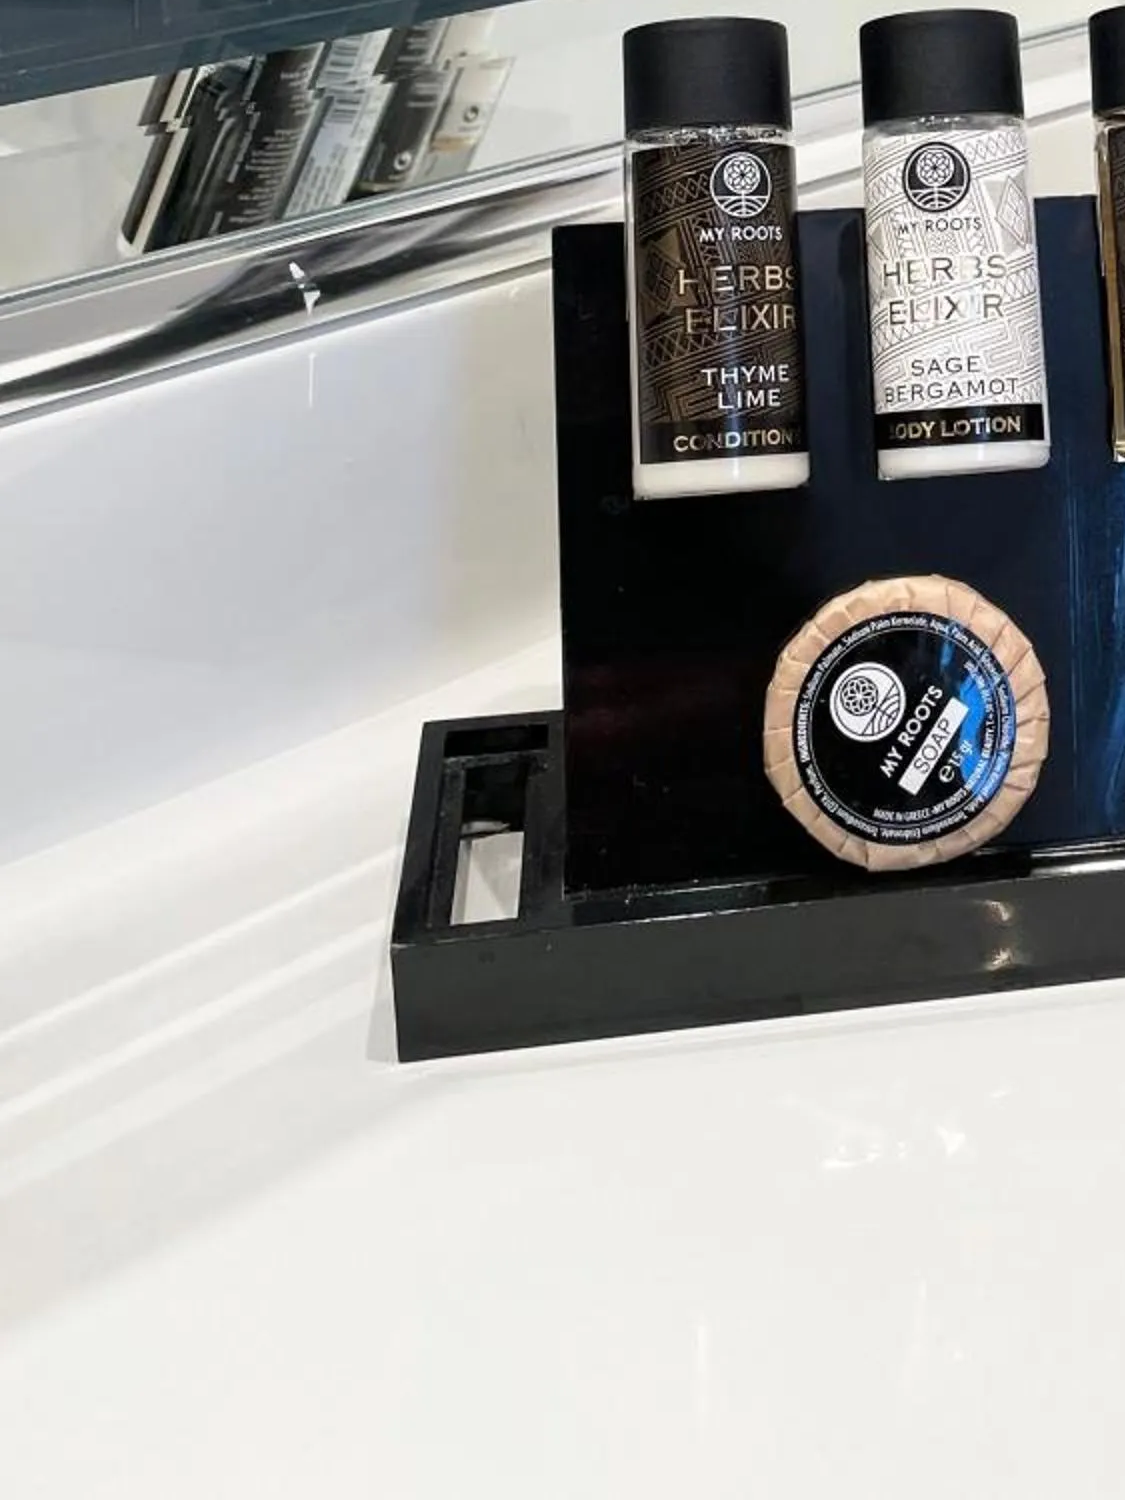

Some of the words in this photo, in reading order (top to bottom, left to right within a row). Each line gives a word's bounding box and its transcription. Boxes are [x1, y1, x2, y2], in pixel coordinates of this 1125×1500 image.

[700, 227, 724, 242] MY
[731, 225, 783, 241] ROOTS
[898, 221, 916, 235] MY
[925, 217, 982, 233] ROOTS
[678, 264, 796, 295] HERBS
[883, 254, 1007, 287] HERBS
[685, 303, 797, 334] ELIXIR
[889, 293, 1004, 326] ELIXIR
[700, 364, 790, 386] THYME
[911, 355, 981, 377] SAGE
[718, 388, 781, 409] LIME
[885, 377, 1018, 403] BERGAMOT
[889, 421, 936, 440] ODY
[941, 415, 1022, 438] LOTION
[880, 746, 903, 778] MY
[897, 685, 943, 747] ROOTS
[913, 717, 951, 774] SOAP
